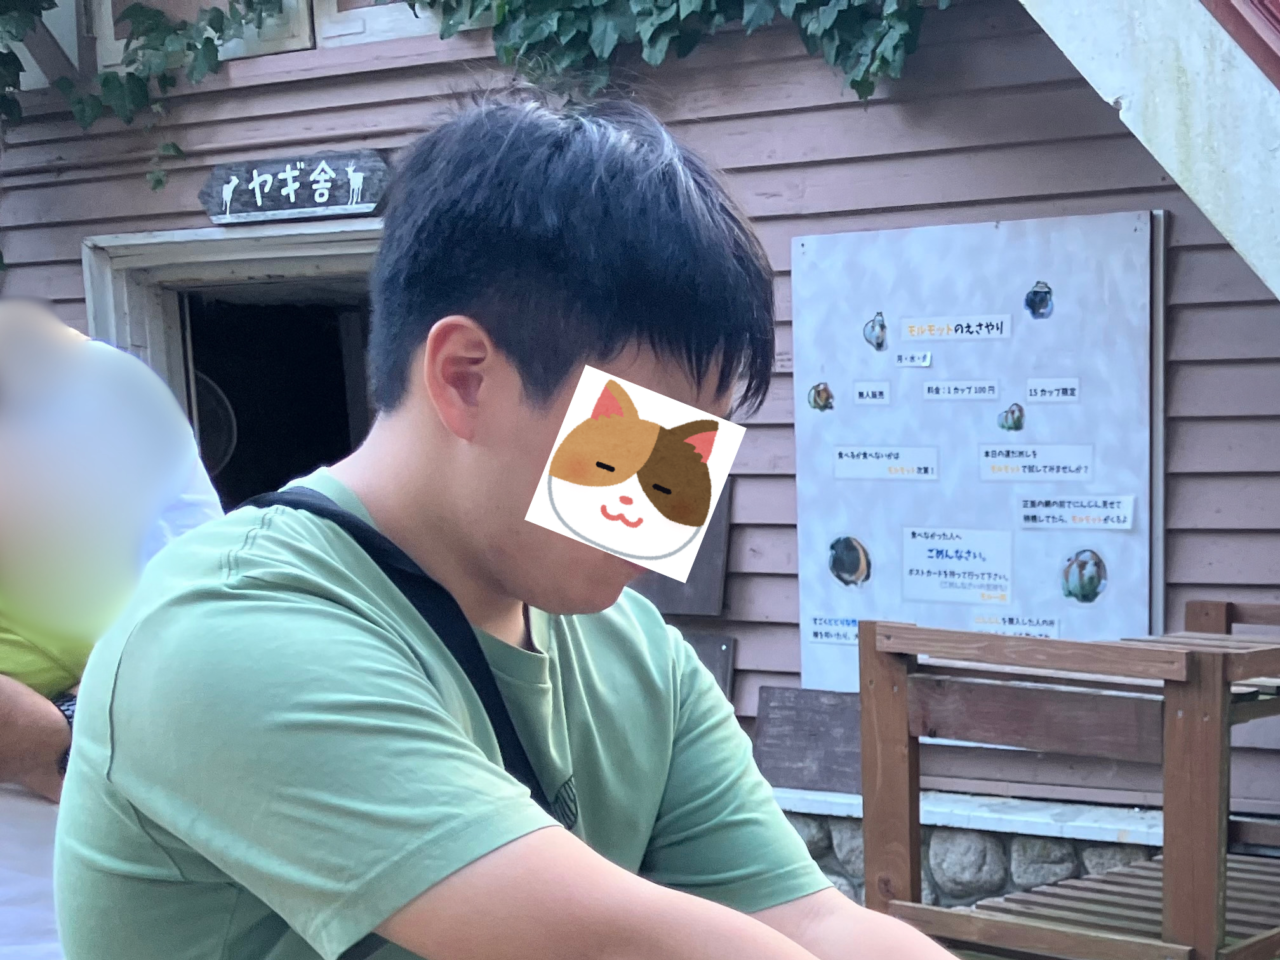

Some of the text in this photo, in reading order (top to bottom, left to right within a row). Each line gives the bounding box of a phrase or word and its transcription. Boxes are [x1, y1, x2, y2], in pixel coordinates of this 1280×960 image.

[248, 160, 336, 206] ヤギ舎
[908, 320, 1004, 337] モルモットのえさやり
